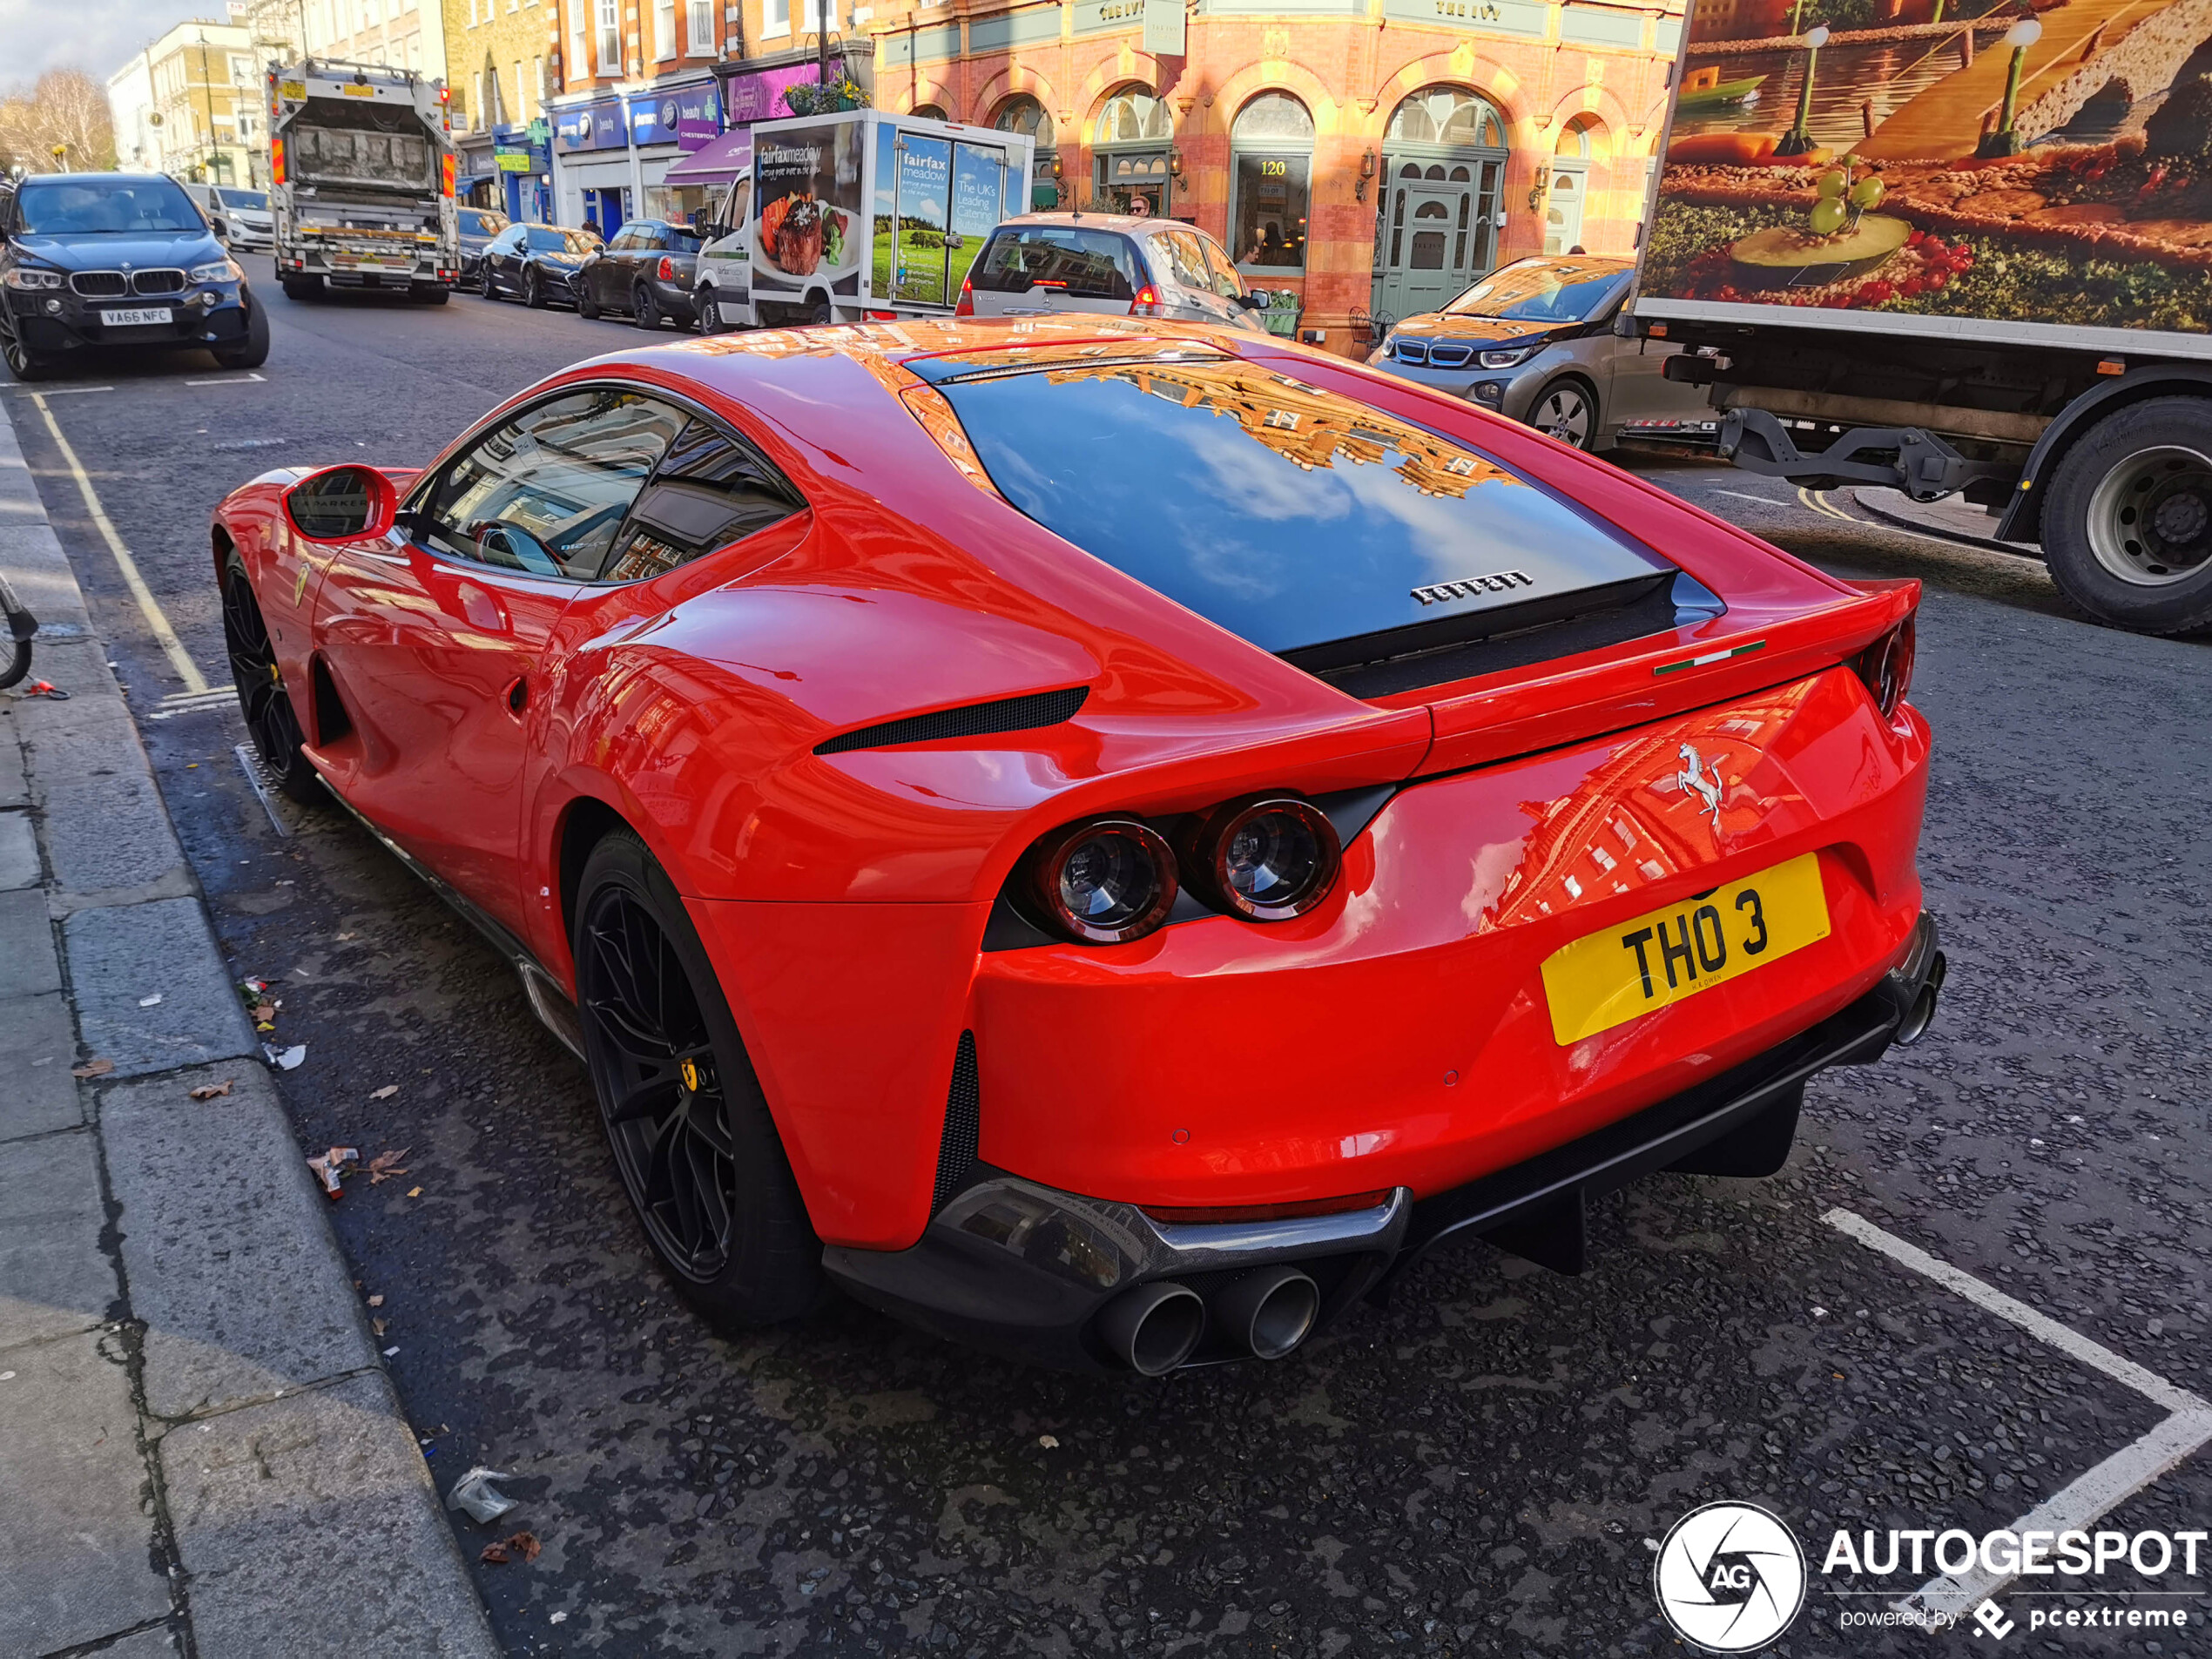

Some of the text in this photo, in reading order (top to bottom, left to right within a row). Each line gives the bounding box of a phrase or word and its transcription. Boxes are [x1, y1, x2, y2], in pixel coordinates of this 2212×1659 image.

[1100, 5, 1122, 21] THE
[1436, 1, 1501, 21] THE IVY
[681, 104, 700, 120] beauty
[598, 117, 614, 132] beauty
[760, 140, 822, 165] fairfaxmeadow
[903, 152, 946, 171] fairfax
[1261, 160, 1286, 176] 120
[902, 167, 946, 181] meadow
[958, 180, 996, 197] The UK's
[957, 192, 989, 211] Leading
[956, 206, 993, 223] Catering
[106, 310, 166, 323] VA66 NFC
[1410, 569, 1534, 607] Ferrari
[1621, 888, 1768, 999] THO 3
